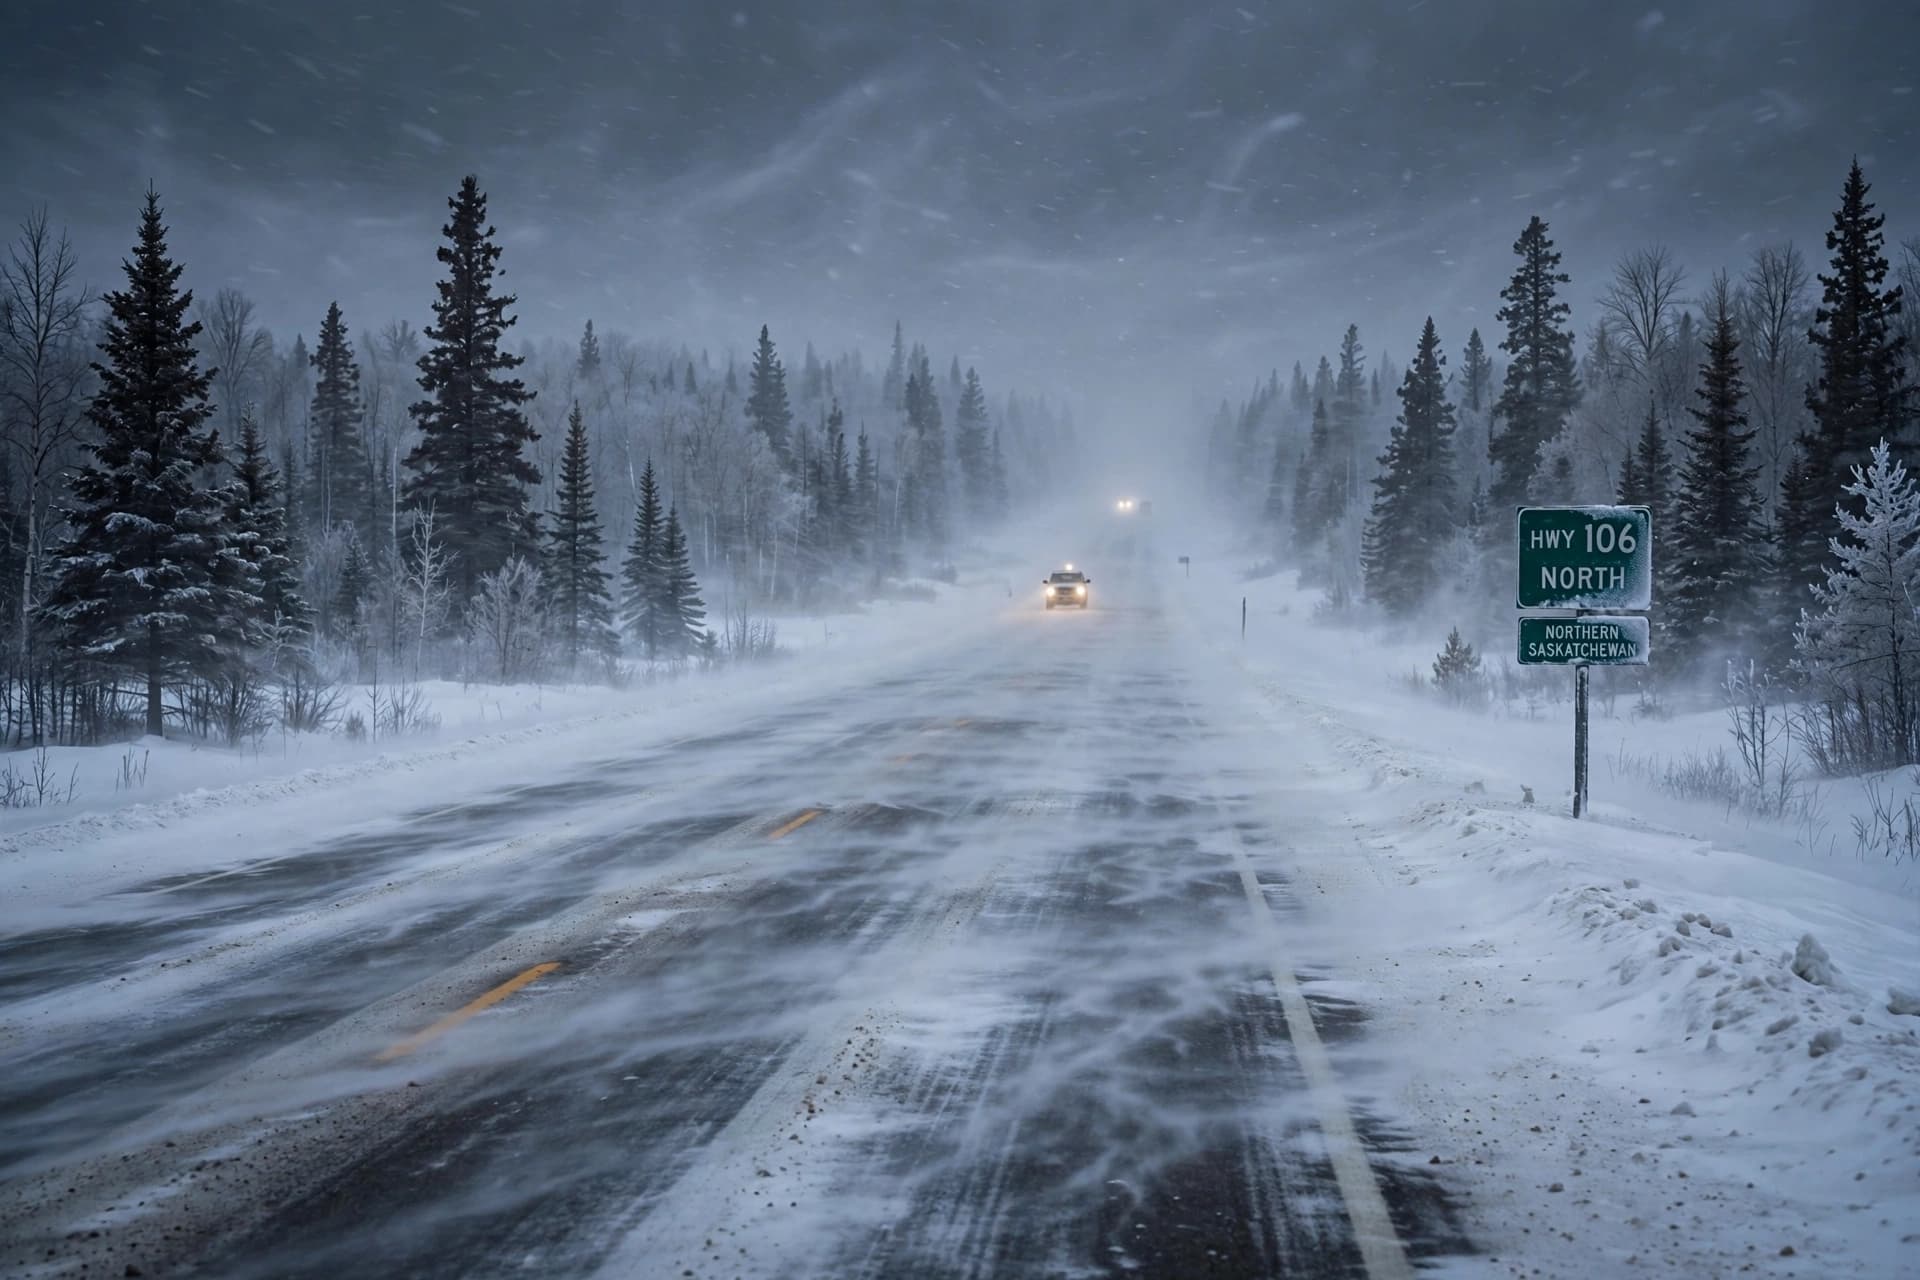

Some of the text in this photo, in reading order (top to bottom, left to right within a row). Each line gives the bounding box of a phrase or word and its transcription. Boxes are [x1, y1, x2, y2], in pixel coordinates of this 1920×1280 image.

[1531, 523, 1636, 554] HWY 106
[1541, 566, 1625, 590] NORTH
[1545, 625, 1619, 640] NORTHERN
[1528, 643, 1637, 657] SASKATCHEWAN
